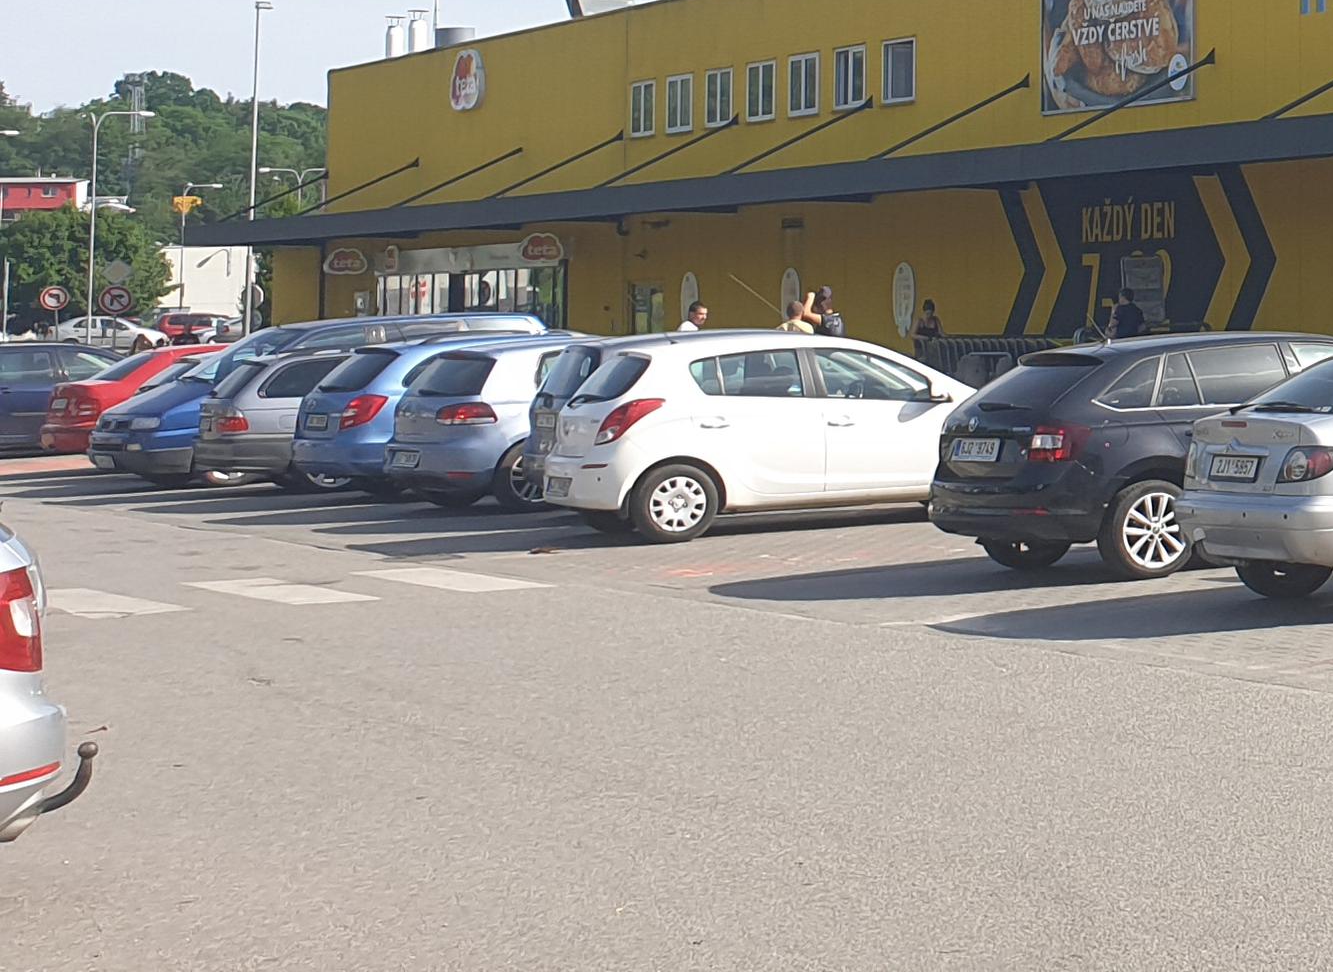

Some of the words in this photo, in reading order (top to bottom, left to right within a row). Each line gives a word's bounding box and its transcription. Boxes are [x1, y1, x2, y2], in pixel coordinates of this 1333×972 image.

[1072, 21, 1105, 46] VŽDY
[1107, 12, 1160, 42] ČERSTVÉ
[1081, 195, 1135, 244] KAŽDÝ
[1141, 201, 1176, 240] DEN
